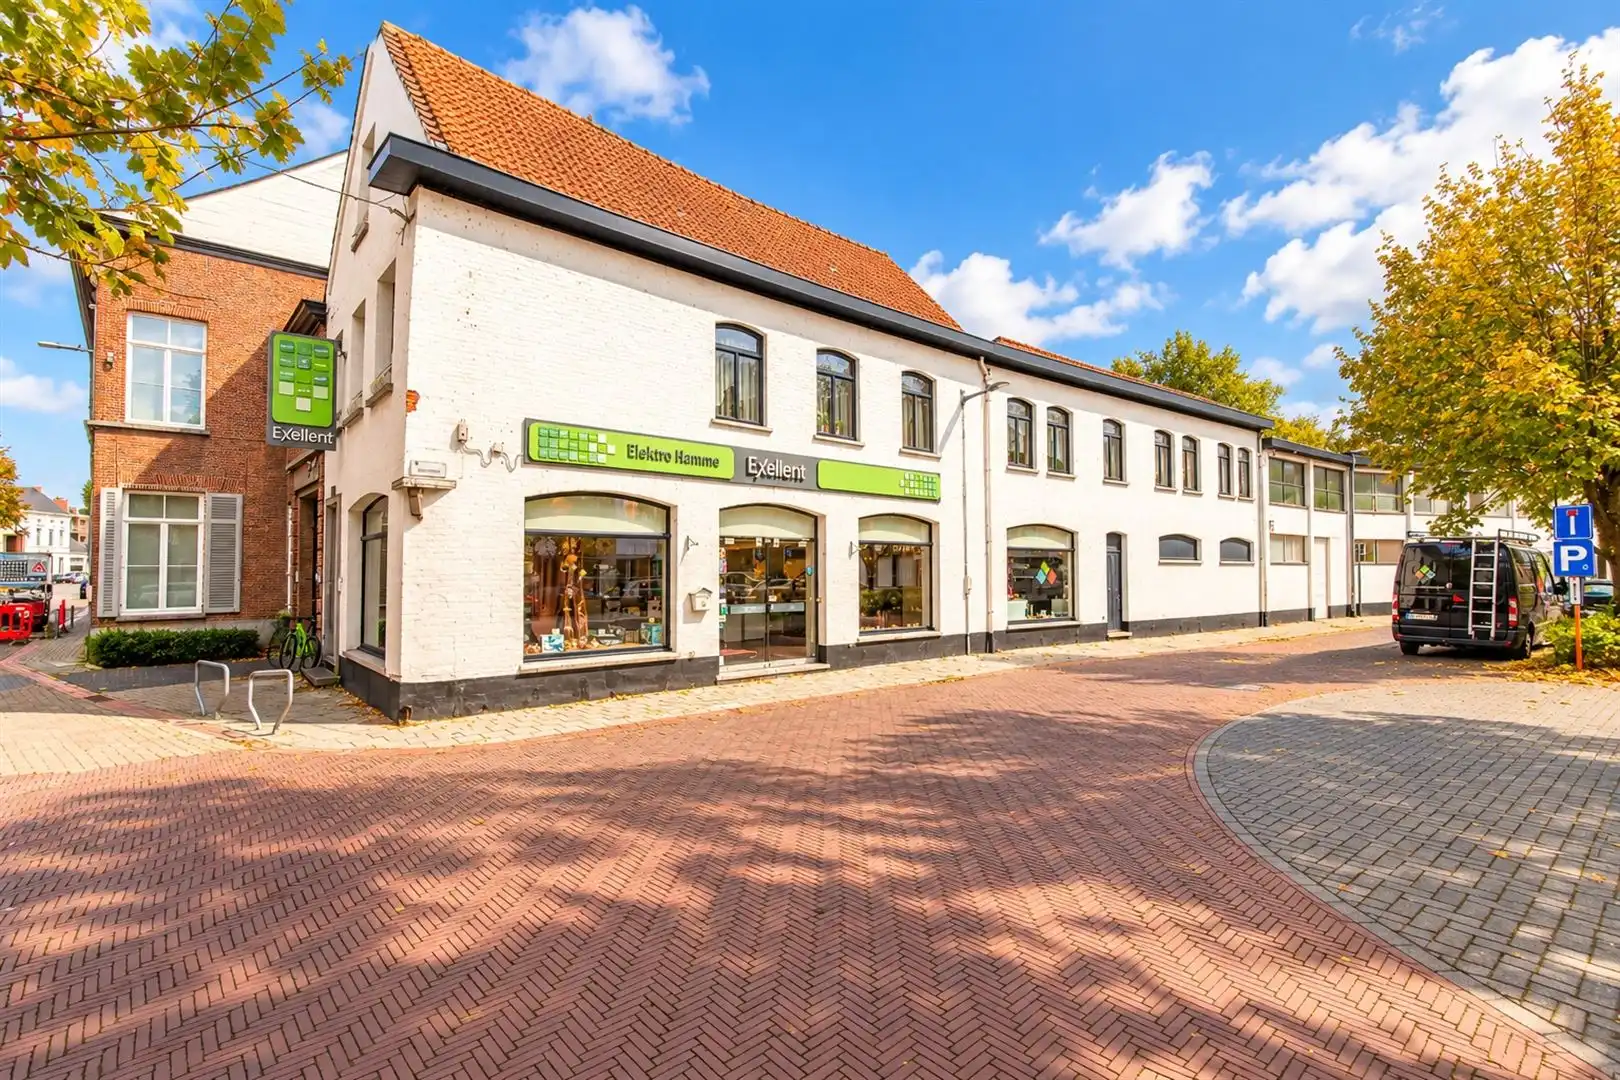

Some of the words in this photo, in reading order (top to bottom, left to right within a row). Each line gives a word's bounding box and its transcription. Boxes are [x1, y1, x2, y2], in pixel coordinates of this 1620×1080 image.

[272, 426, 334, 444] Exellent
[627, 443, 672, 463] Elektro
[675, 449, 720, 469] Hamme
[747, 456, 806, 481] Exellent
[1560, 545, 1588, 572] P
